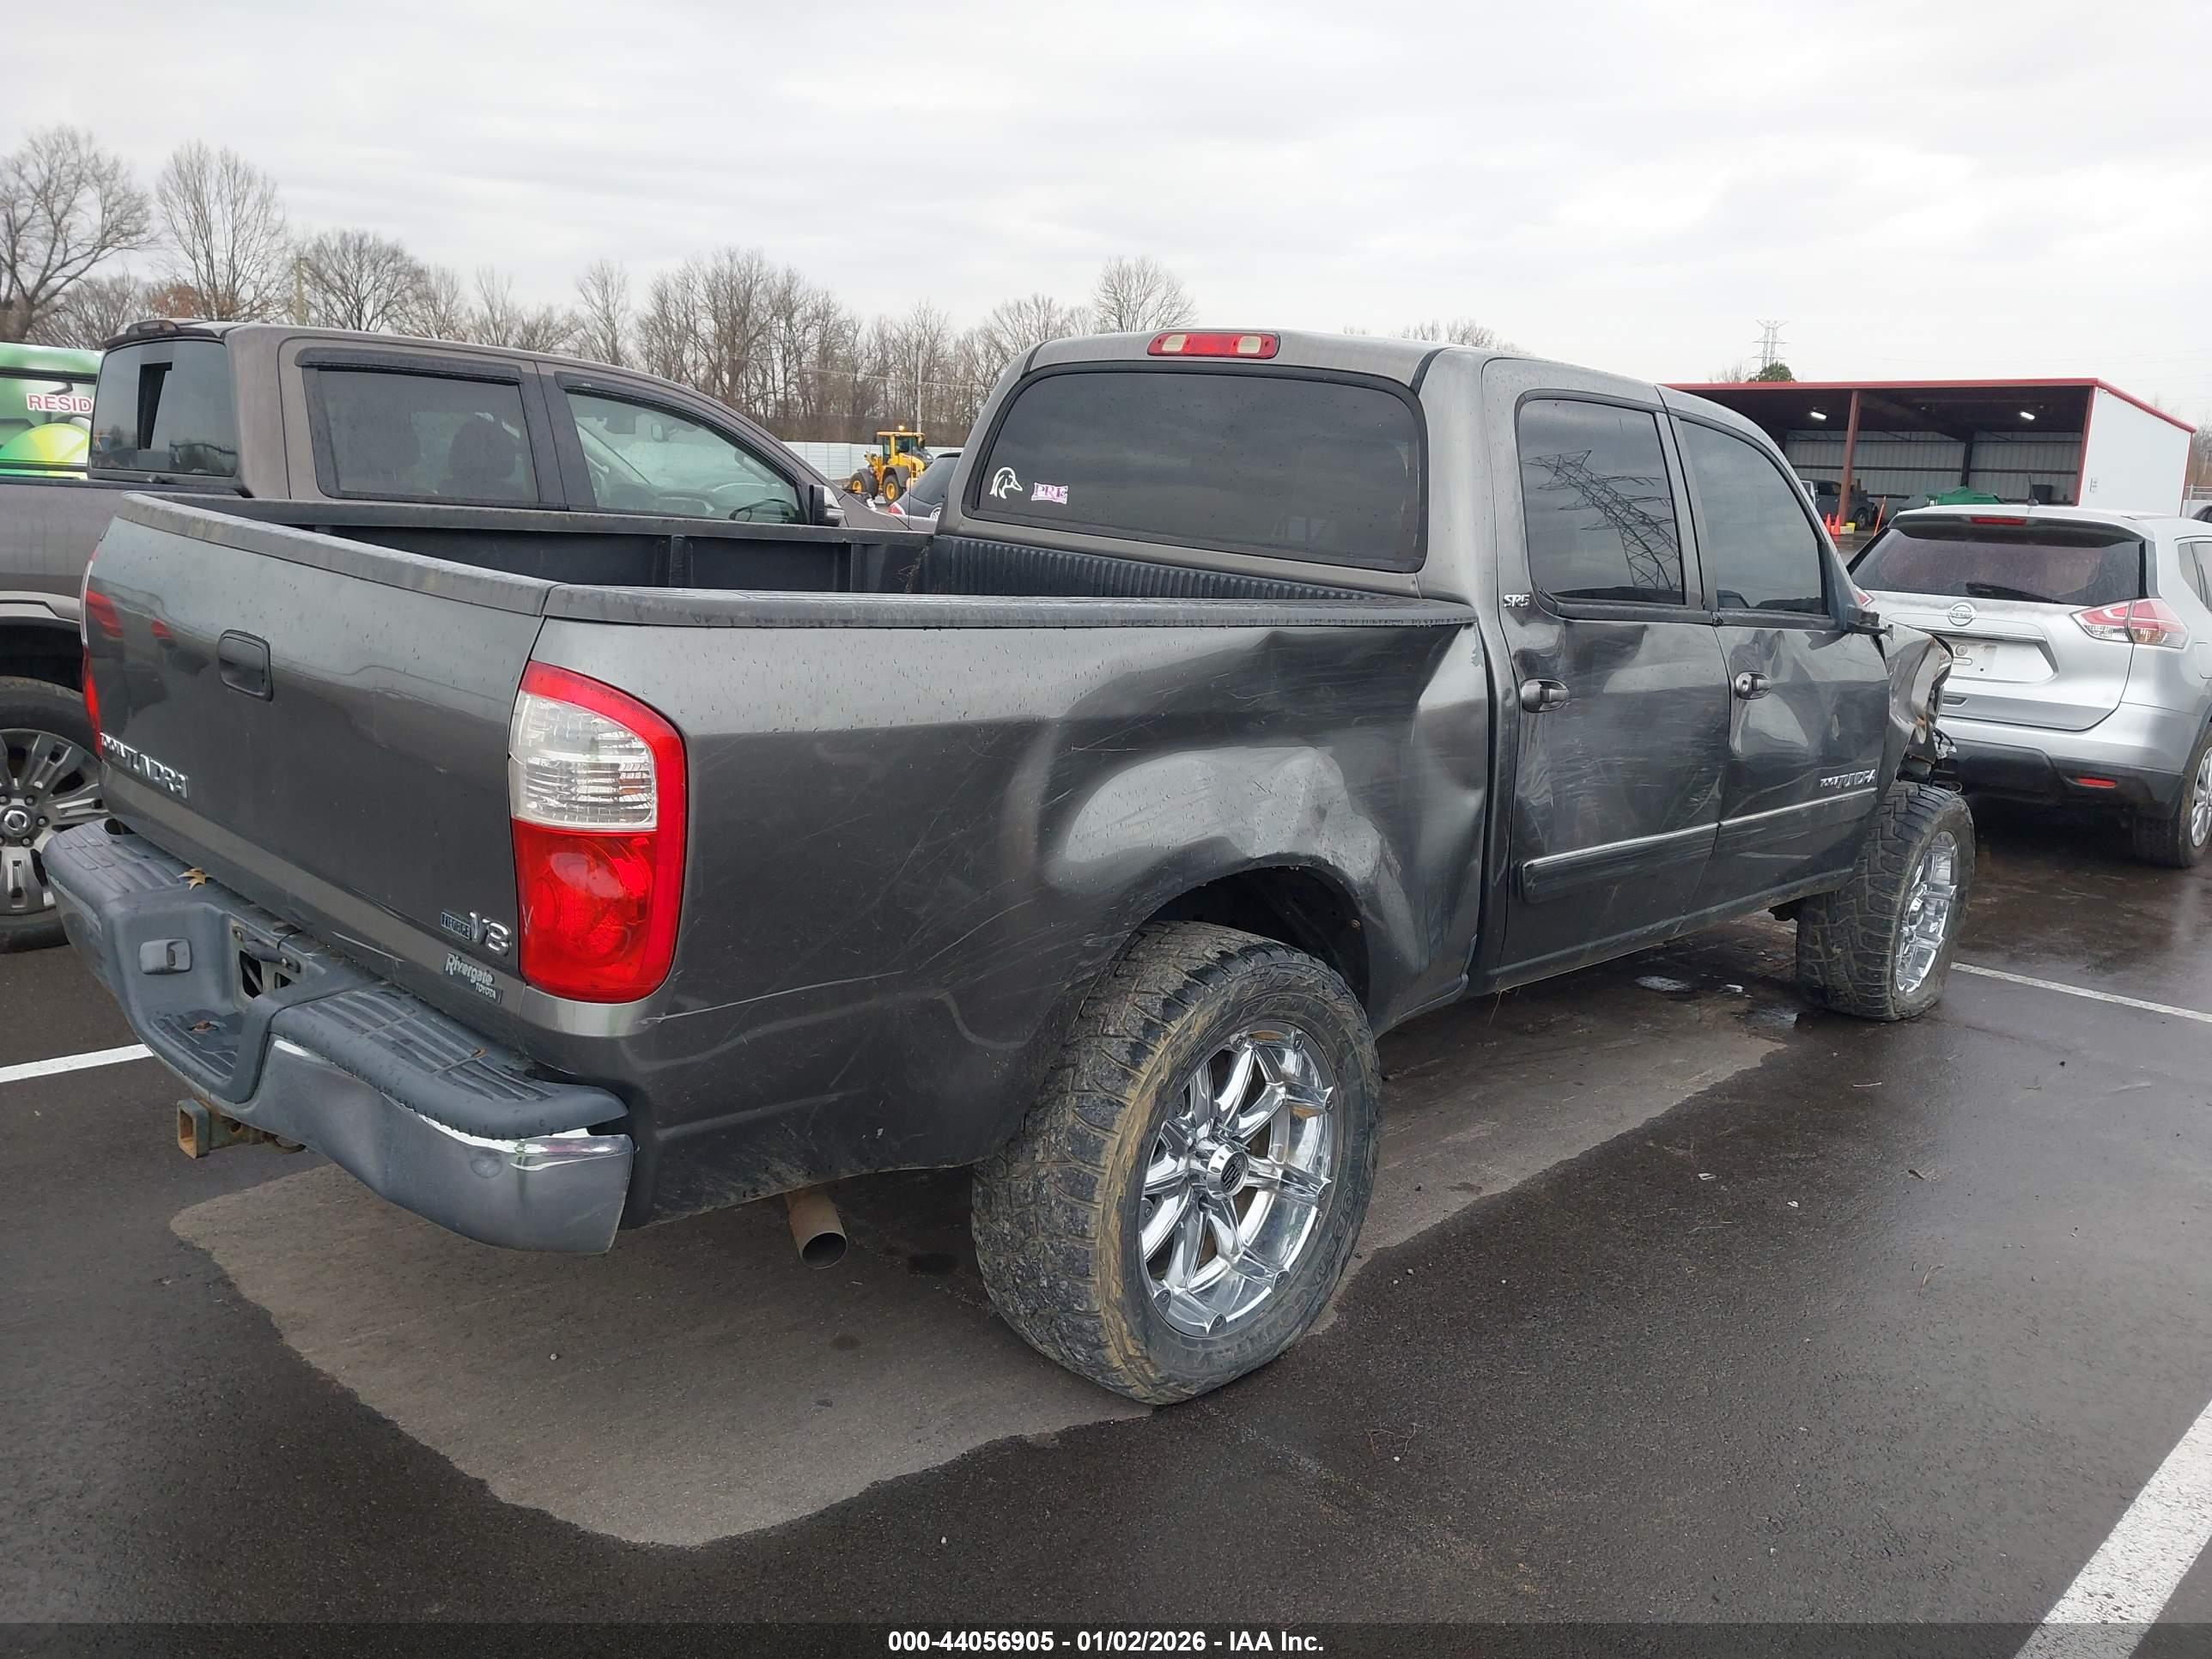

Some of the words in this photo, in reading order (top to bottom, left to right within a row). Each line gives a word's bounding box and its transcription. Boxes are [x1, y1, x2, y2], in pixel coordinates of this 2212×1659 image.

[469, 911, 512, 956] V8
[445, 952, 495, 987] Rivergate
[475, 981, 496, 1000] TOYOTA
